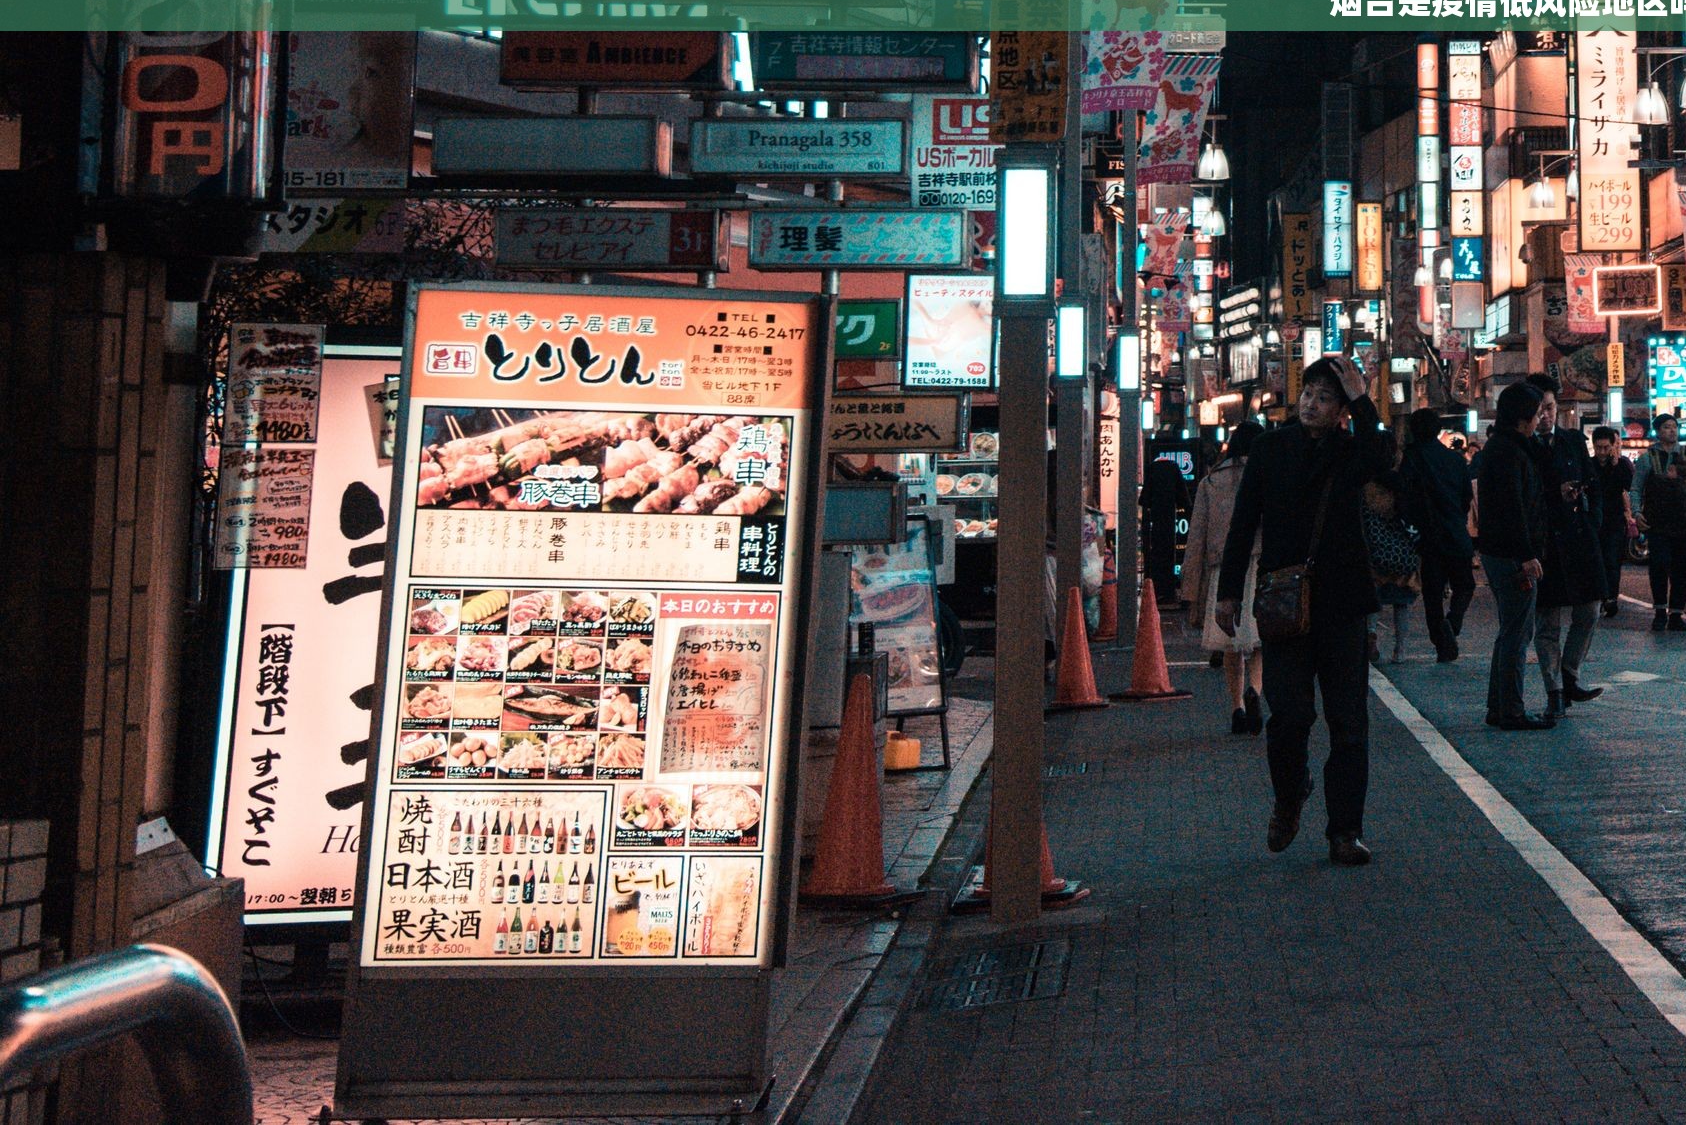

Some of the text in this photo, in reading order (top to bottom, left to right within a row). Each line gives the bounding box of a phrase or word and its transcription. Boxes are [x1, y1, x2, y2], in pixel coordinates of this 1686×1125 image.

[788, 35, 957, 57] 吉祥寺情報センター
[1590, 45, 1609, 157] ミライザカ
[749, 129, 873, 151] Pranagala 358
[802, 159, 835, 171] studio
[1588, 180, 1632, 193] ハイボール
[1588, 212, 1632, 225] 生ビール
[779, 226, 843, 252] 理髪
[461, 311, 657, 335] 吉祥寺っ子居酒屋
[732, 313, 760, 322] TEL
[685, 325, 805, 340] 0422-46-2417
[879, 341, 892, 351] 2F
[484, 333, 656, 385] とりとん
[911, 377, 987, 386] TEL:0422-79-1588
[520, 479, 601, 507] 豚巻串
[739, 525, 764, 574] 串料理
[763, 522, 781, 576] とりとんの
[661, 598, 775, 615] 本日のおすすめ
[678, 639, 762, 654] 本日のおすすめ
[398, 795, 433, 855] 焼酎
[386, 859, 475, 893] 日本酒
[614, 869, 676, 895] ビール
[383, 907, 482, 943] 果実酒
[383, 943, 428, 955] 種類豊富
